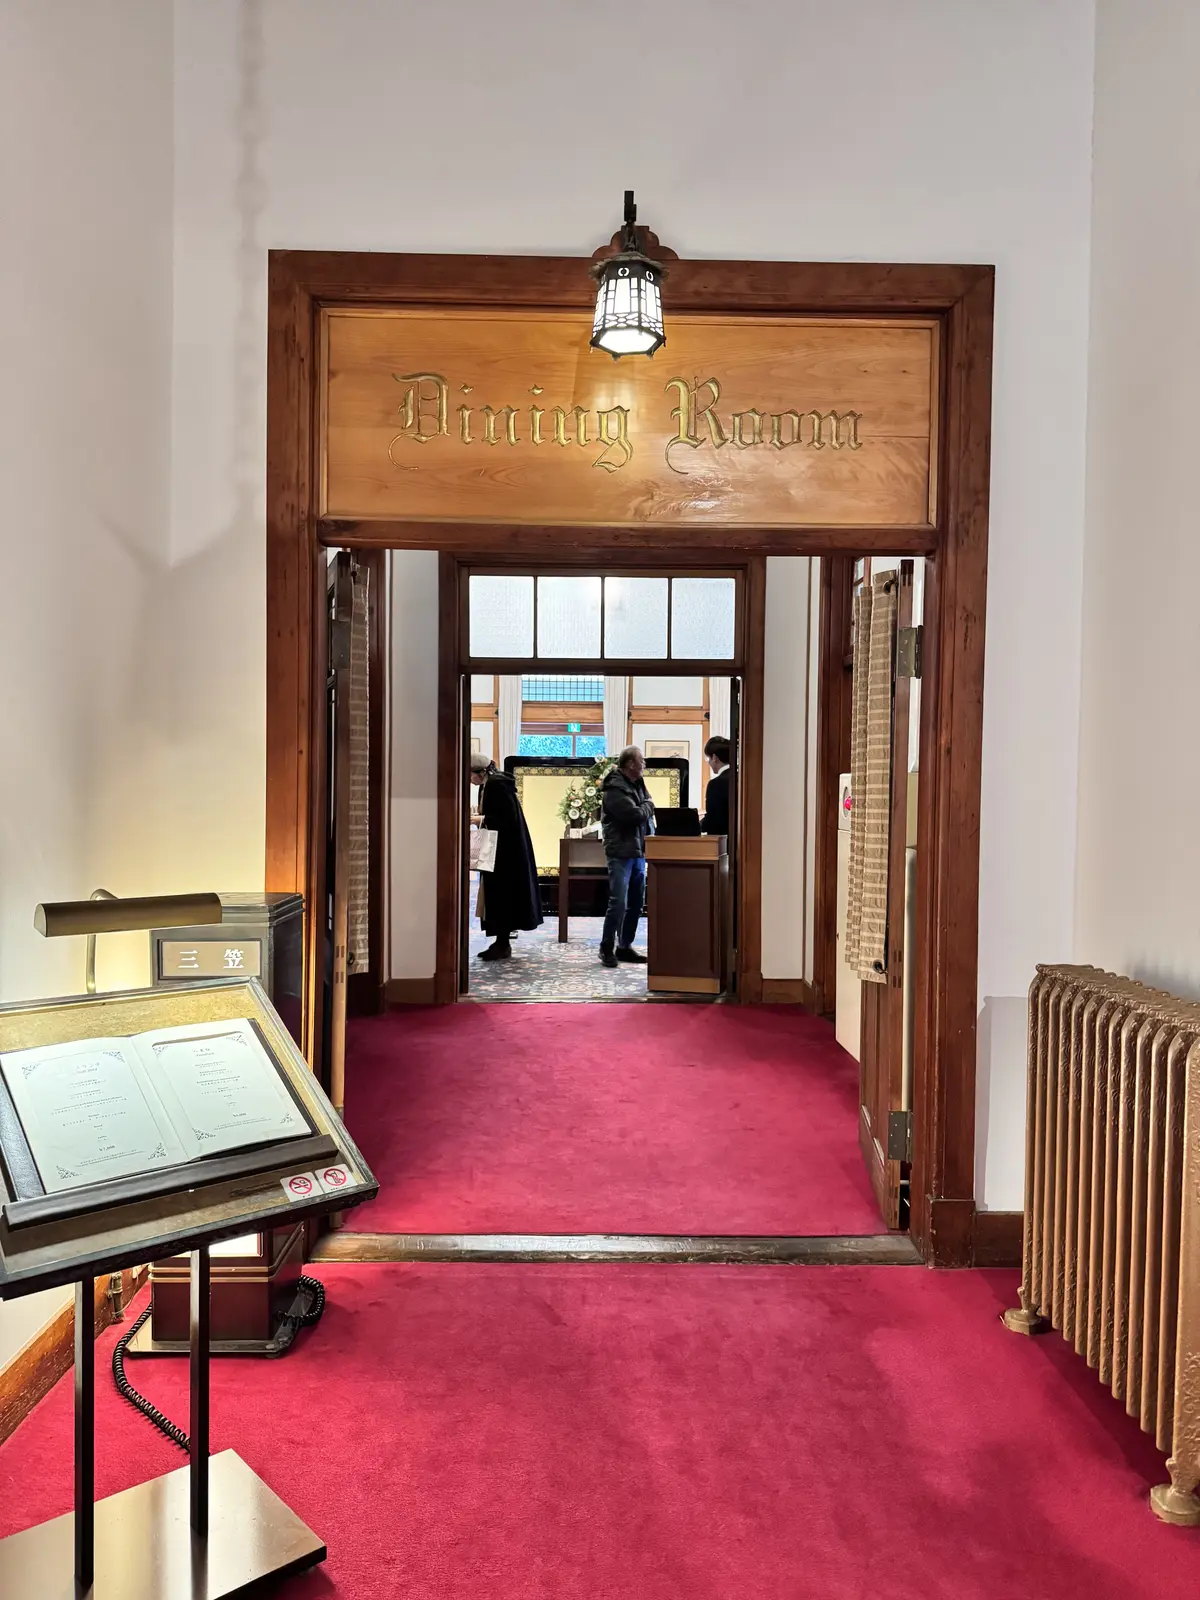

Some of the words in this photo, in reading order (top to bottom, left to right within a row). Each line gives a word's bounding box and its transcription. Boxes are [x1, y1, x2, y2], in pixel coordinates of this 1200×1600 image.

[388, 372, 634, 474] Dining
[664, 375, 863, 474] Room
[178, 948, 244, 969] 三笠
